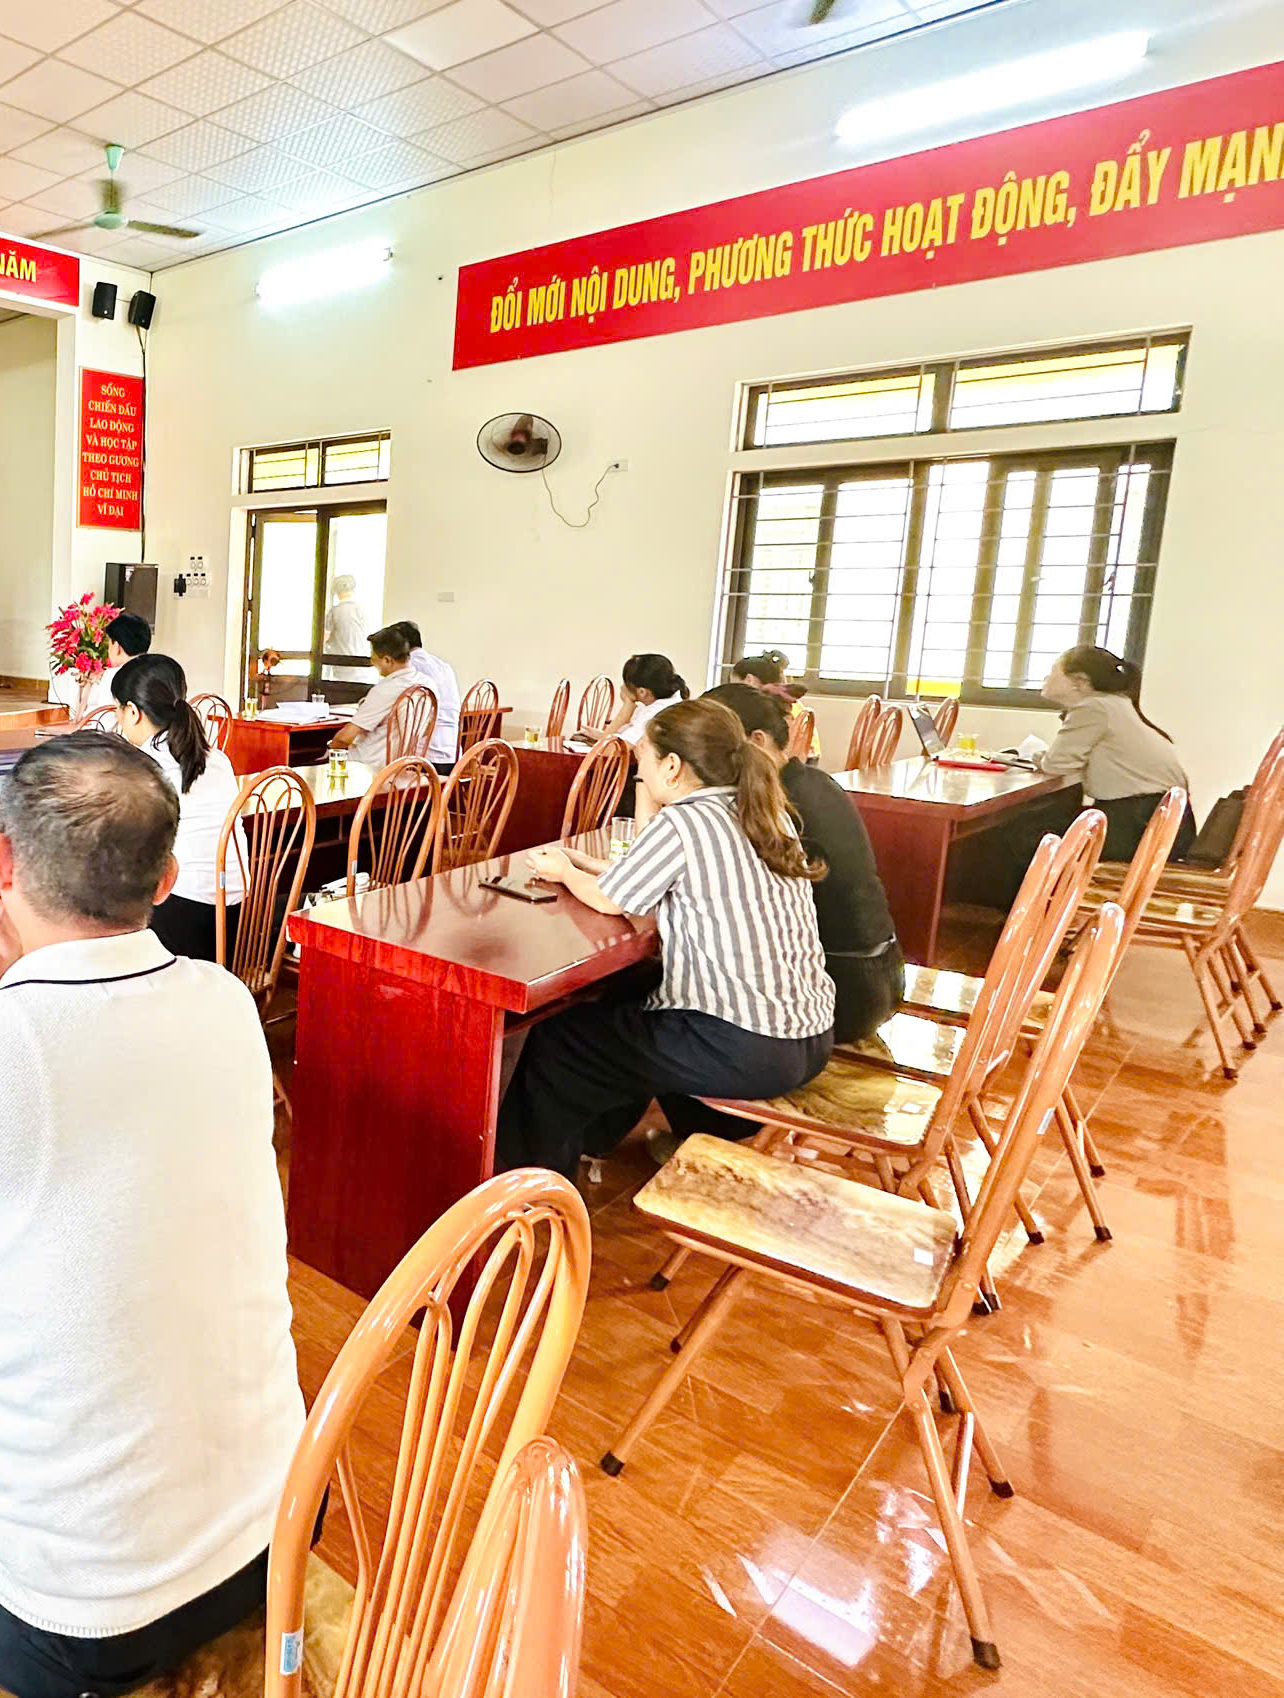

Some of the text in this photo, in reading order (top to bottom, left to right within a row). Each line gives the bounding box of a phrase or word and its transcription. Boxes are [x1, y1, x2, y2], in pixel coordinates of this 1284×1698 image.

[490, 121, 1284, 333] ĐỔI MỚI NỘI DUNG, PHƯƠNG THỨC HOẠT ĐỘNG, ĐẨY MẠN
[100, 382, 126, 398] SỐNG
[88, 399, 117, 414] CHIẾN
[89, 417, 134, 433] LAO ĐỘNG
[85, 433, 98, 446] VÀ
[100, 436, 119, 449] HỌC
[82, 452, 107, 465] THEO
[90, 467, 132, 484] CHỦ TỊCH
[97, 486, 114, 498] CHÍ
[115, 488, 139, 501] MINH
